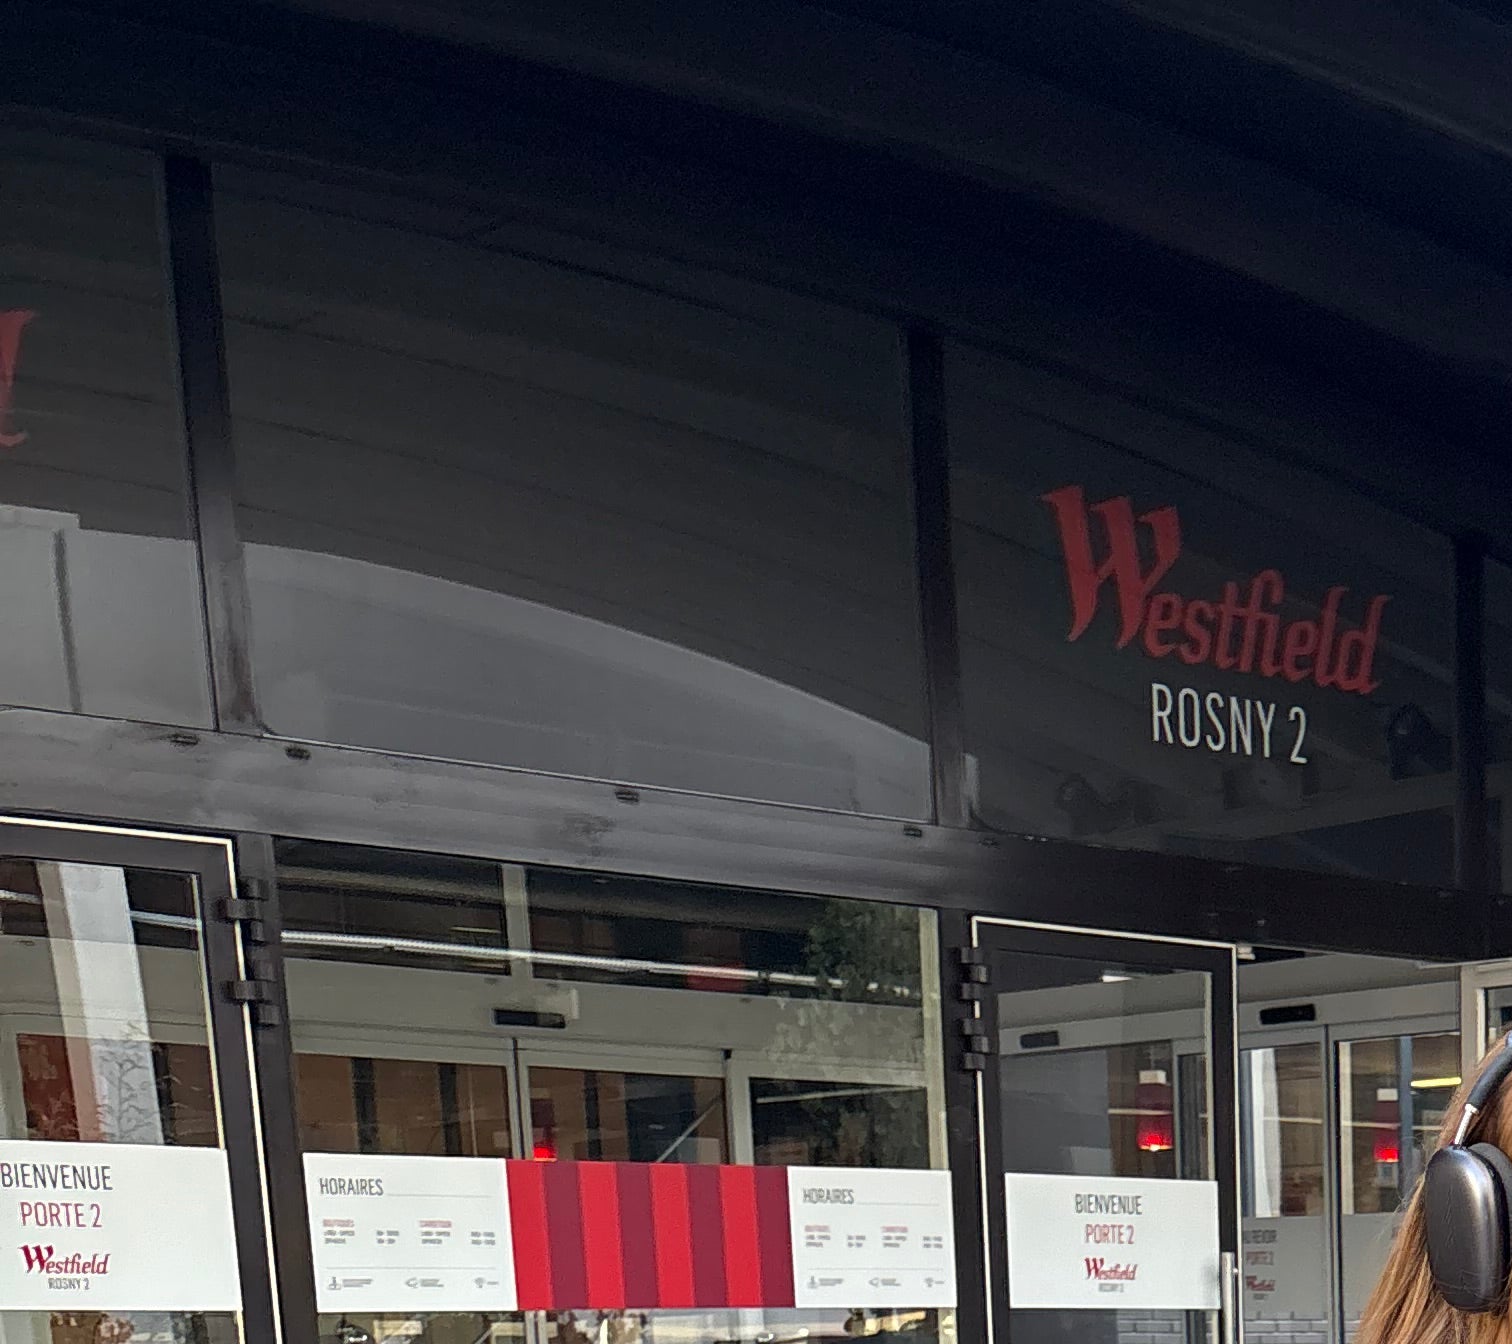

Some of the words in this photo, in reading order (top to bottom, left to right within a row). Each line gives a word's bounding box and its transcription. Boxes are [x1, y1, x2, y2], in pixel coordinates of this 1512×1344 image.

[1039, 484, 1394, 695] Westfield
[1150, 682, 1275, 759] ROSNY
[1288, 706, 1308, 765] 2
[0, 1162, 113, 1191] BIENVENUE
[319, 1177, 384, 1196] HORAIRES
[802, 1188, 854, 1205] HORAIRES
[1075, 1193, 1143, 1216] BIENVENUE
[20, 1201, 87, 1228] PORTE
[90, 1203, 103, 1228] 2
[1084, 1223, 1125, 1245] PORTE
[1127, 1225, 1135, 1245] 2
[18, 1244, 111, 1275] Westfield
[1084, 1257, 1138, 1281] Westfield
